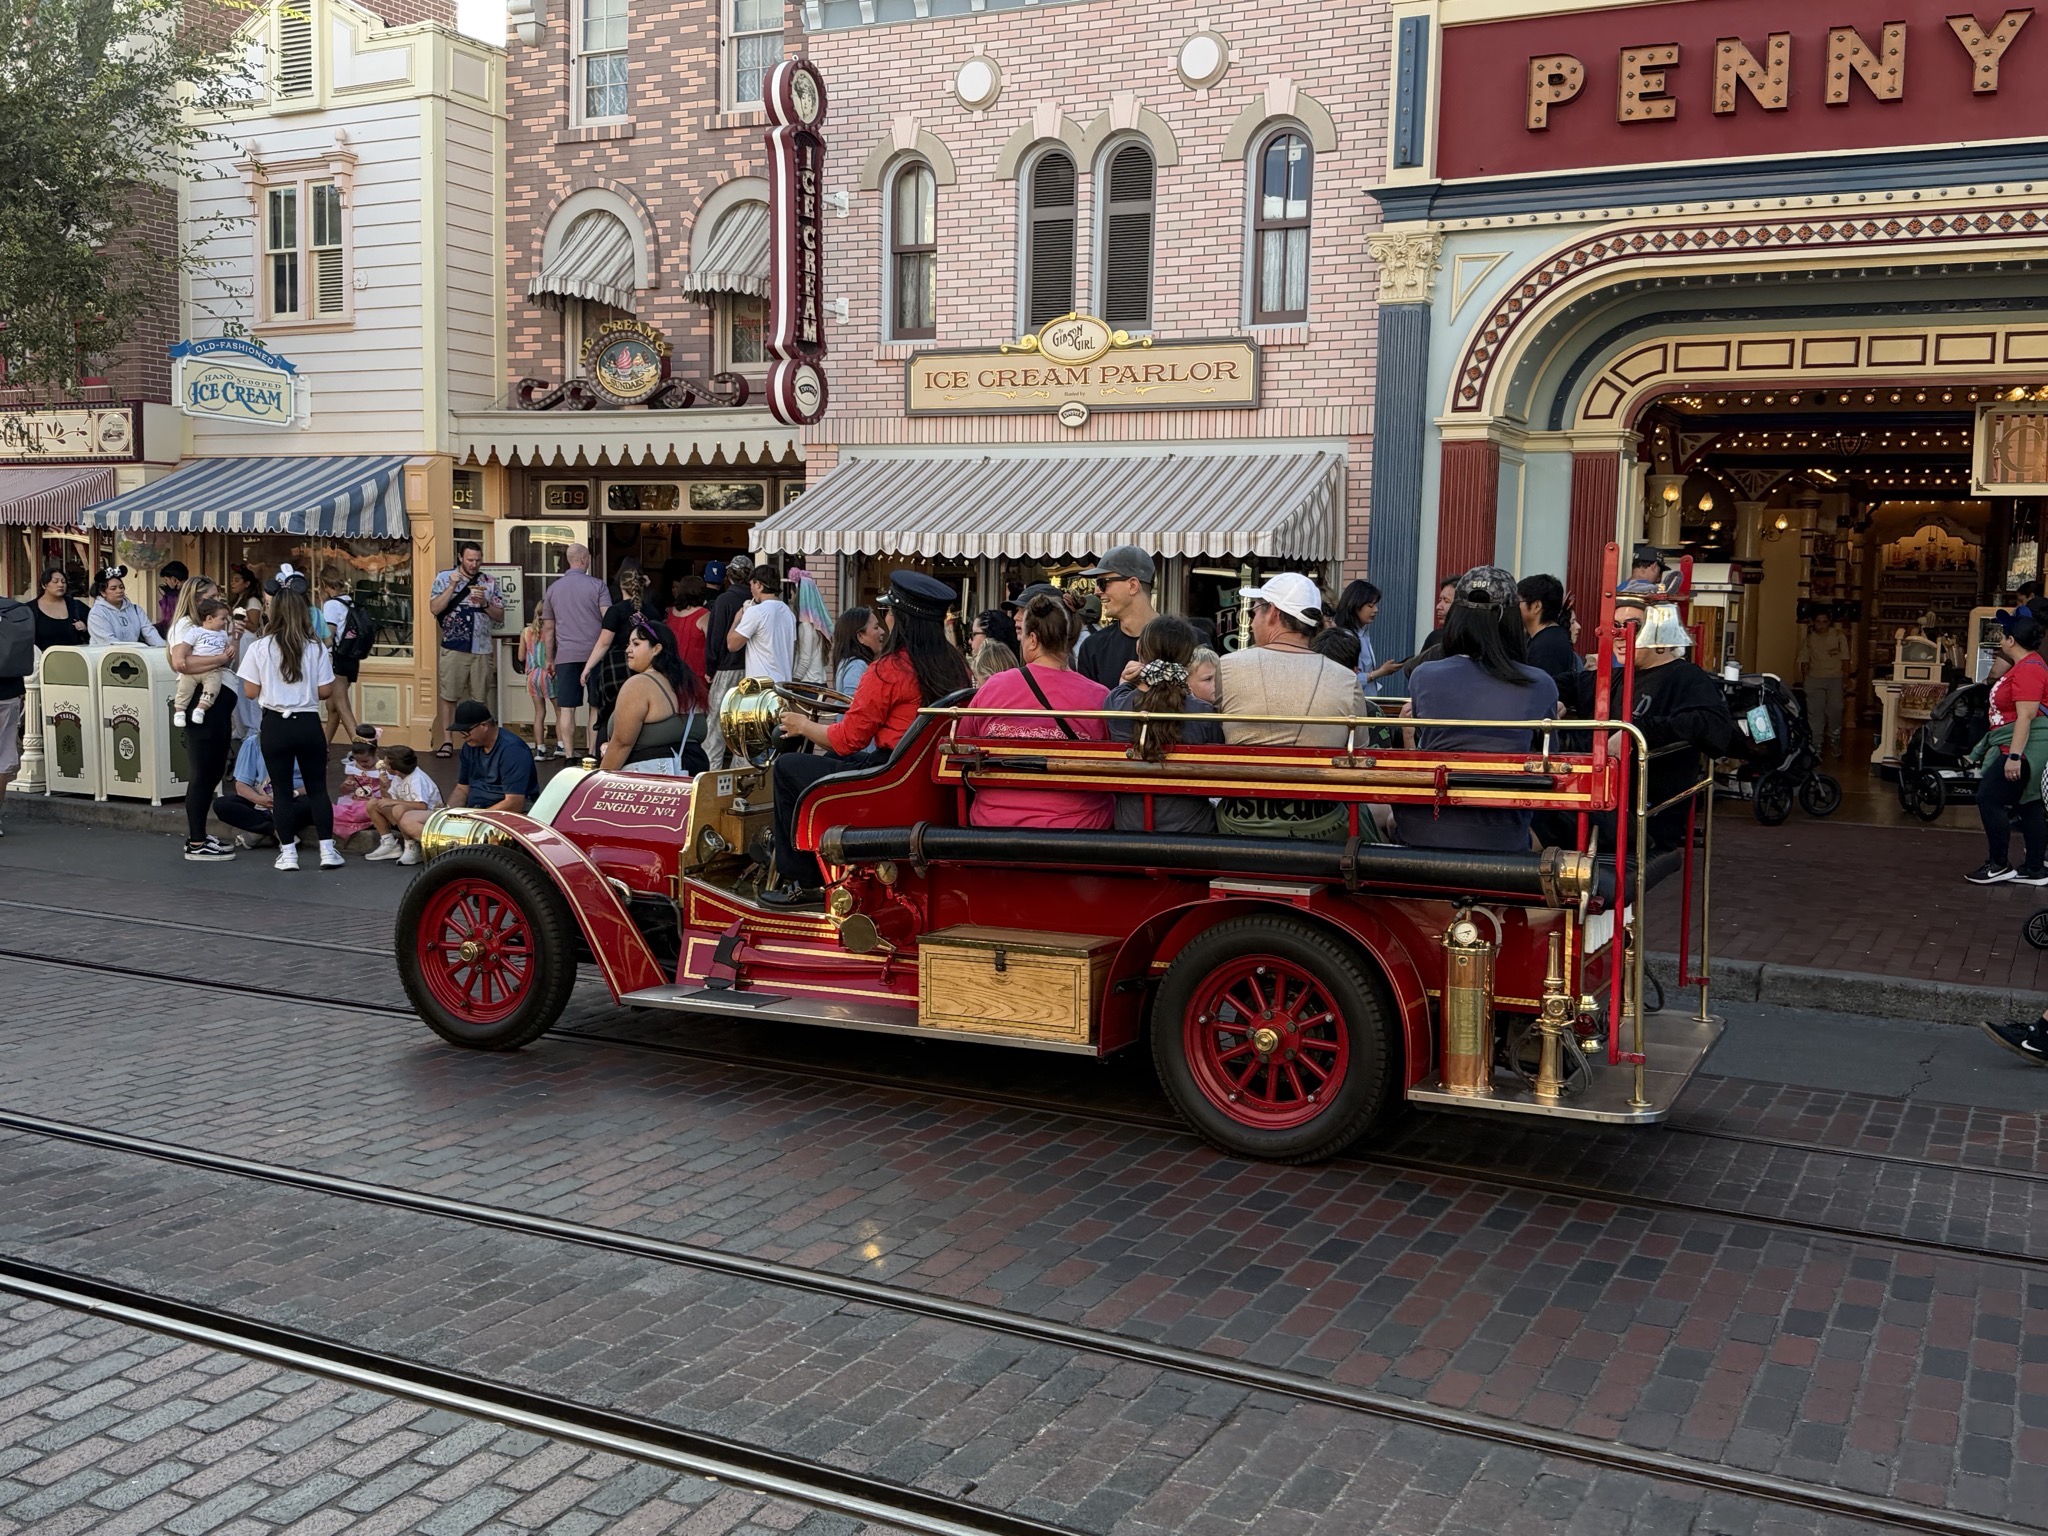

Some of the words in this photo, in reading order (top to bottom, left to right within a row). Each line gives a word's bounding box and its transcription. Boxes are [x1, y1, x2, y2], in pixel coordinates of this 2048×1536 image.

[1526, 8, 2035, 132] PENNY
[802, 145, 816, 219] ICE
[803, 225, 818, 343] CREAM
[1053, 324, 1083, 347] GIBSON
[1074, 336, 1096, 351] GIRL
[195, 341, 274, 365] OLD-FASHIONED
[579, 337, 594, 364] ICE
[204, 374, 234, 382] HAND
[236, 378, 282, 389] SCOOPED
[610, 380, 646, 390] SUNDAES
[924, 371, 969, 390] ICE
[978, 366, 1090, 388] CREAM
[1099, 361, 1241, 385] PARLOR
[190, 380, 220, 407] ICE
[221, 381, 283, 415] CREAM
[550, 490, 585, 505] 209
[600, 791, 638, 802] FIRE
[640, 794, 681, 807] DEPT.
[602, 781, 692, 796] DISNEYLAND
[592, 801, 649, 815] ENGINE
